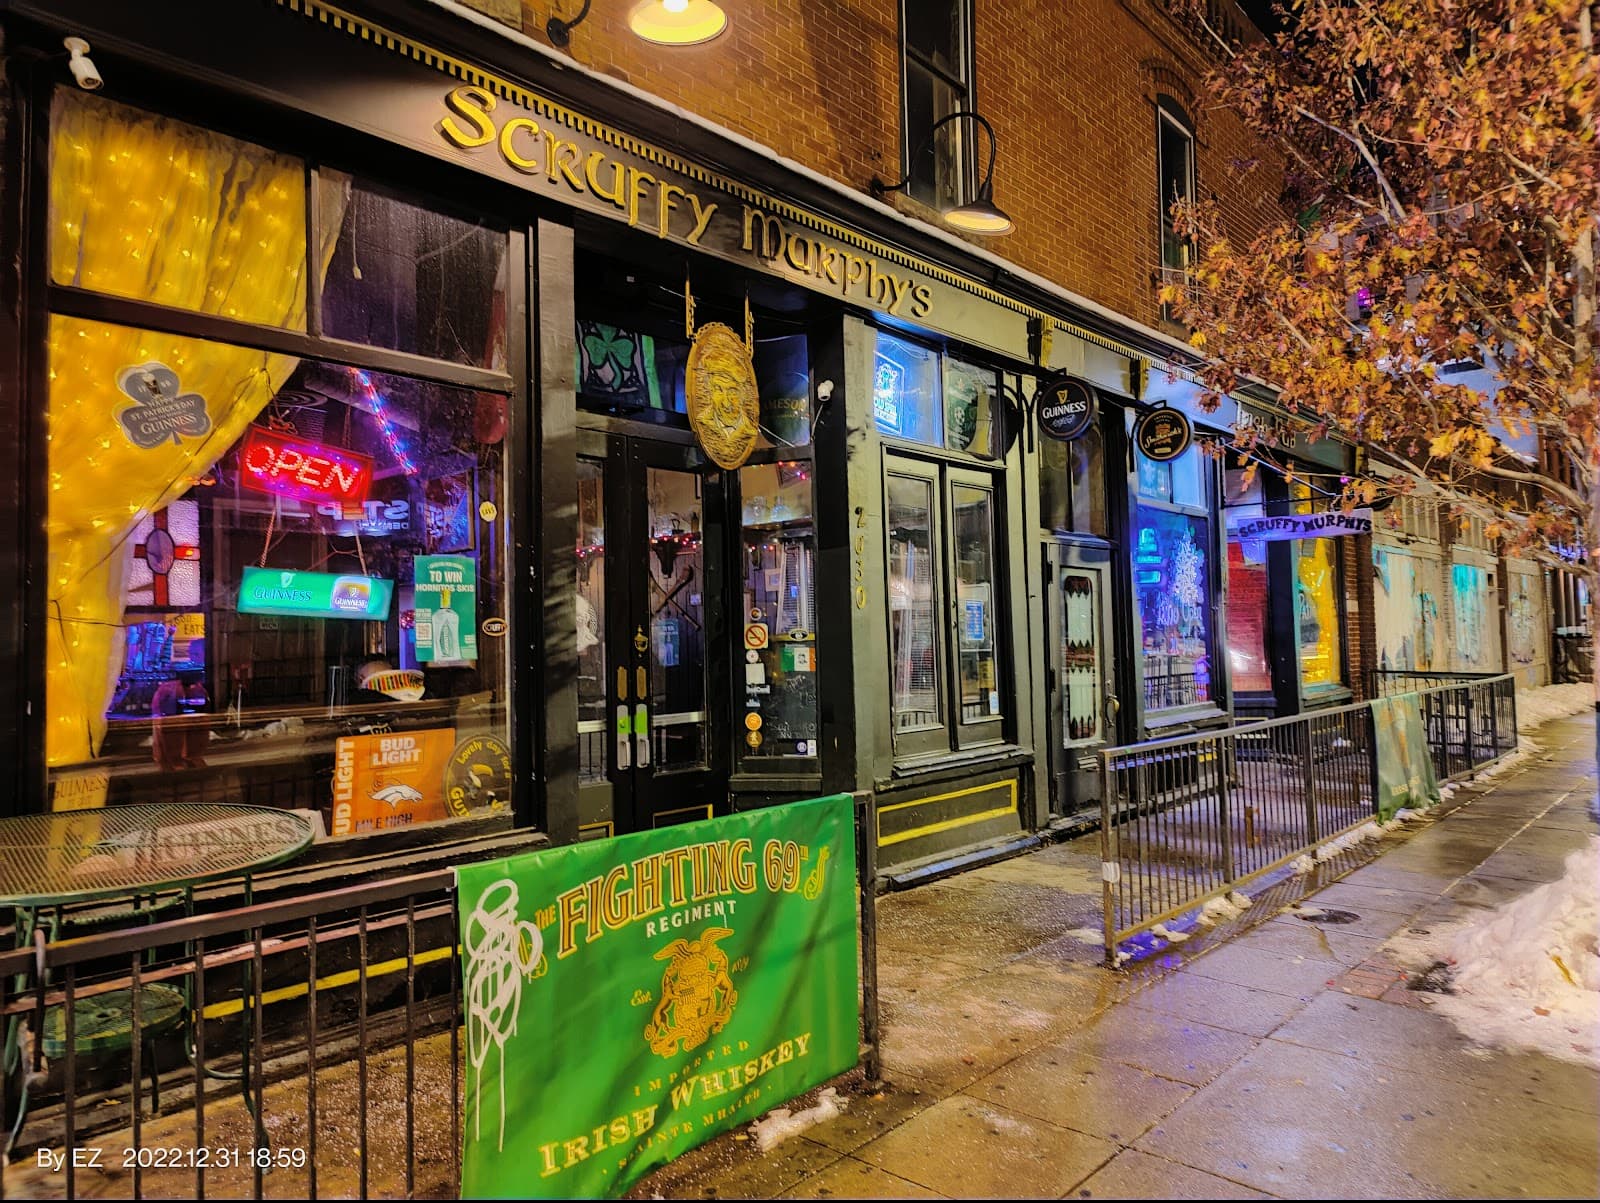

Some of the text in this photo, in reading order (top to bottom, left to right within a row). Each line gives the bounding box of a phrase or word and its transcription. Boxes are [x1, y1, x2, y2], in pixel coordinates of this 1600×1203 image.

[1042, 401, 1087, 419] GUINNESS
[141, 413, 197, 434] GUINNESS
[246, 446, 360, 492] OPEN
[1239, 518, 1300, 537] SCRUFFY
[430, 571, 463, 583] TO WIN
[254, 585, 312, 602] GUINNESS
[380, 736, 416, 752] BUD
[456, 740, 483, 765] Lovely
[372, 749, 423, 766] LIGHT
[335, 739, 355, 837] UD LIGHT
[535, 905, 556, 930] THE
[557, 838, 757, 960] FIGHTING
[646, 900, 736, 938] REGIMENT
[634, 1040, 749, 1097] IMPORTED
[538, 1033, 811, 1178] IRISH WHISKEY
